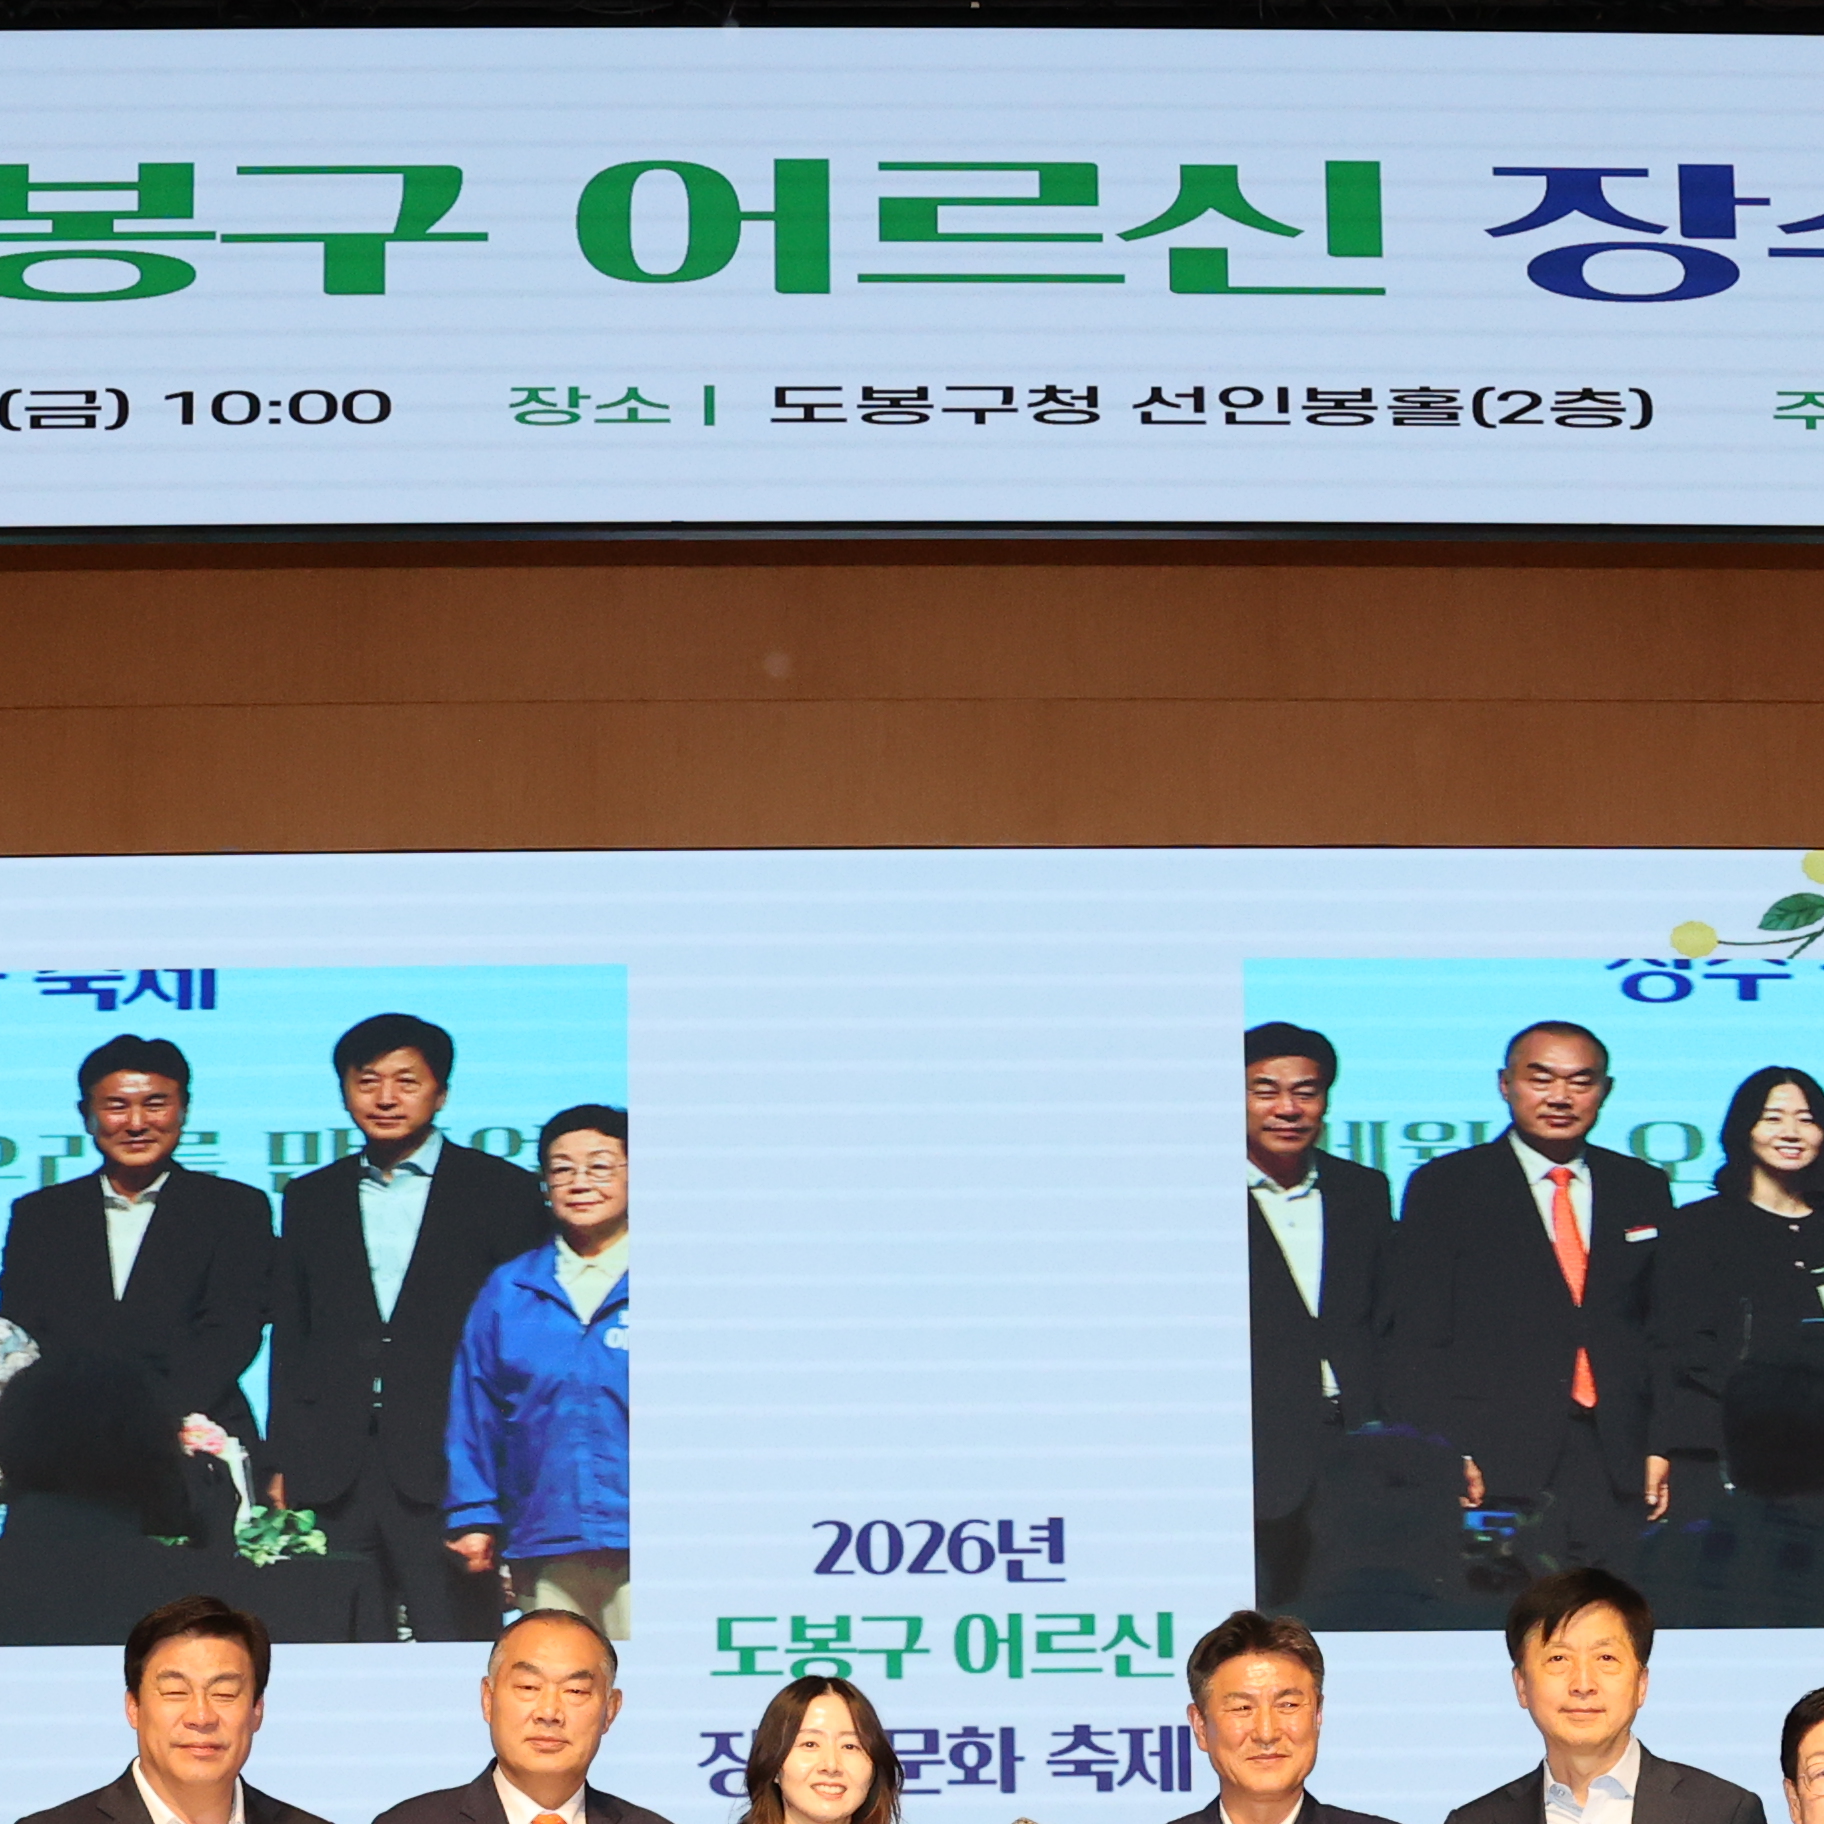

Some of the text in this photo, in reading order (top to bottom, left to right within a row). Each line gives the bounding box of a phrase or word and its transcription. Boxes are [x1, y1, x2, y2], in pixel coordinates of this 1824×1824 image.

[575, 157, 1386, 296] 어르신
[163, 388, 393, 427] 10:00
[508, 383, 1655, 431] 장소 도봉구청 선인봉홀(2층)
[811, 1515, 1067, 1583] 2026년
[709, 1610, 1175, 1680] 도봉구 어르신
[882, 1726, 1026, 1795] 문화
[1045, 1724, 1194, 1794] 축제
